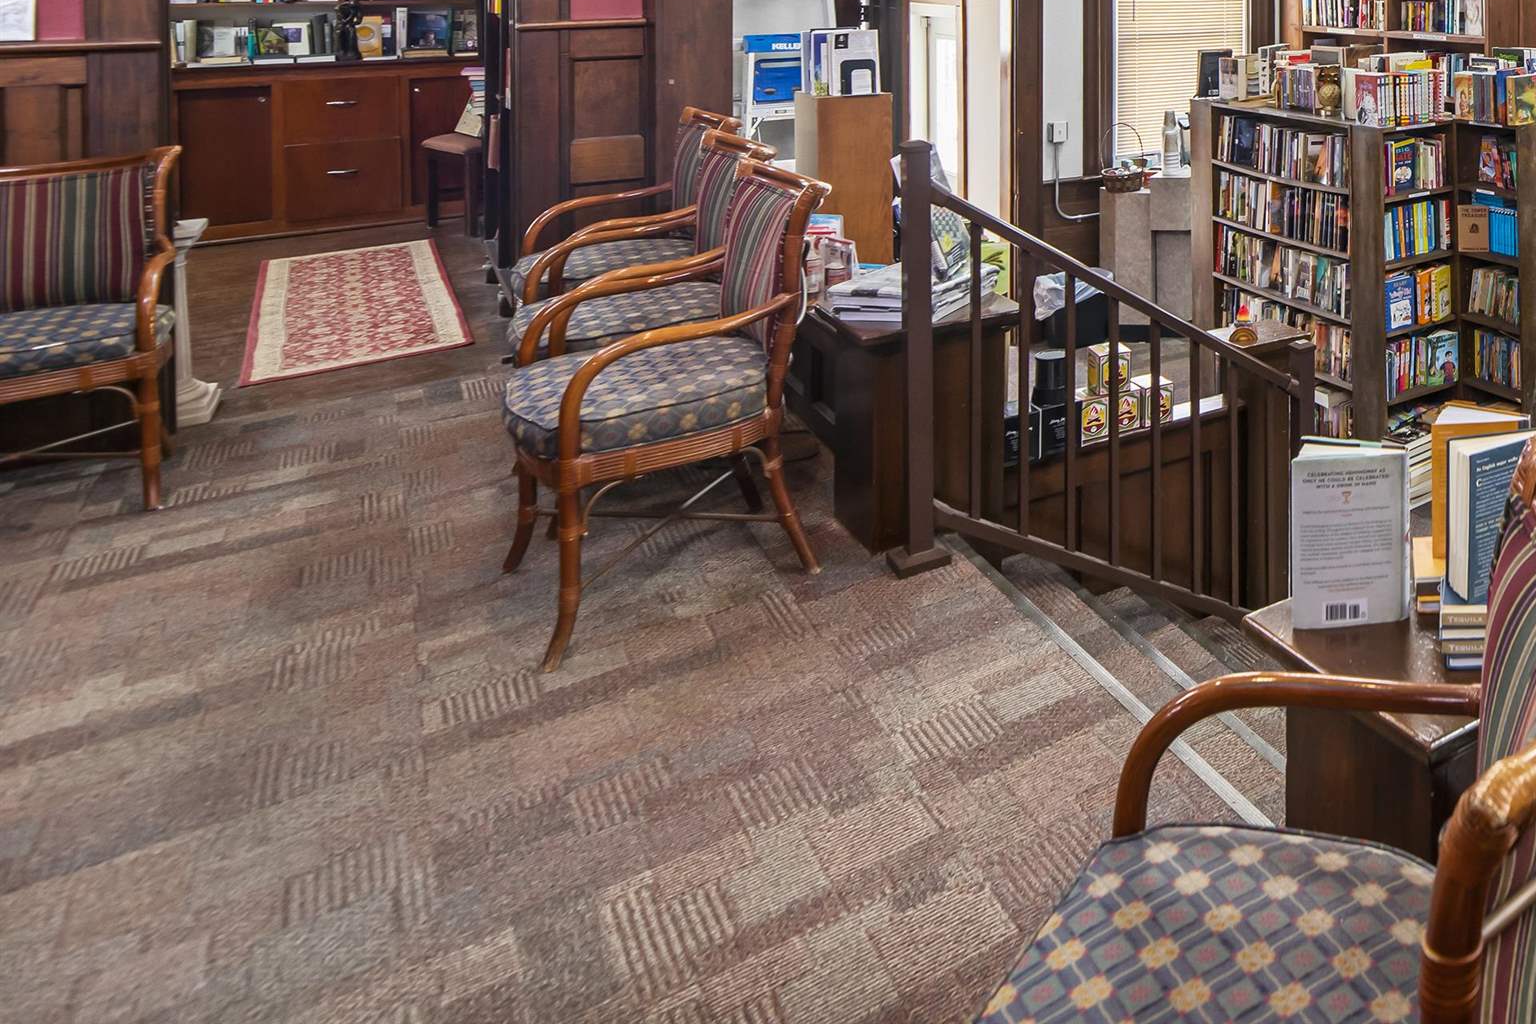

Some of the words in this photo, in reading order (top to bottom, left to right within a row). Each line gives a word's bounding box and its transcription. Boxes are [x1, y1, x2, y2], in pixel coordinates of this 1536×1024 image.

[771, 42, 801, 51] KELLE
[1482, 462, 1496, 471] English
[1447, 615, 1483, 625] TEQUILA
[1448, 642, 1484, 652] TEQUILA
